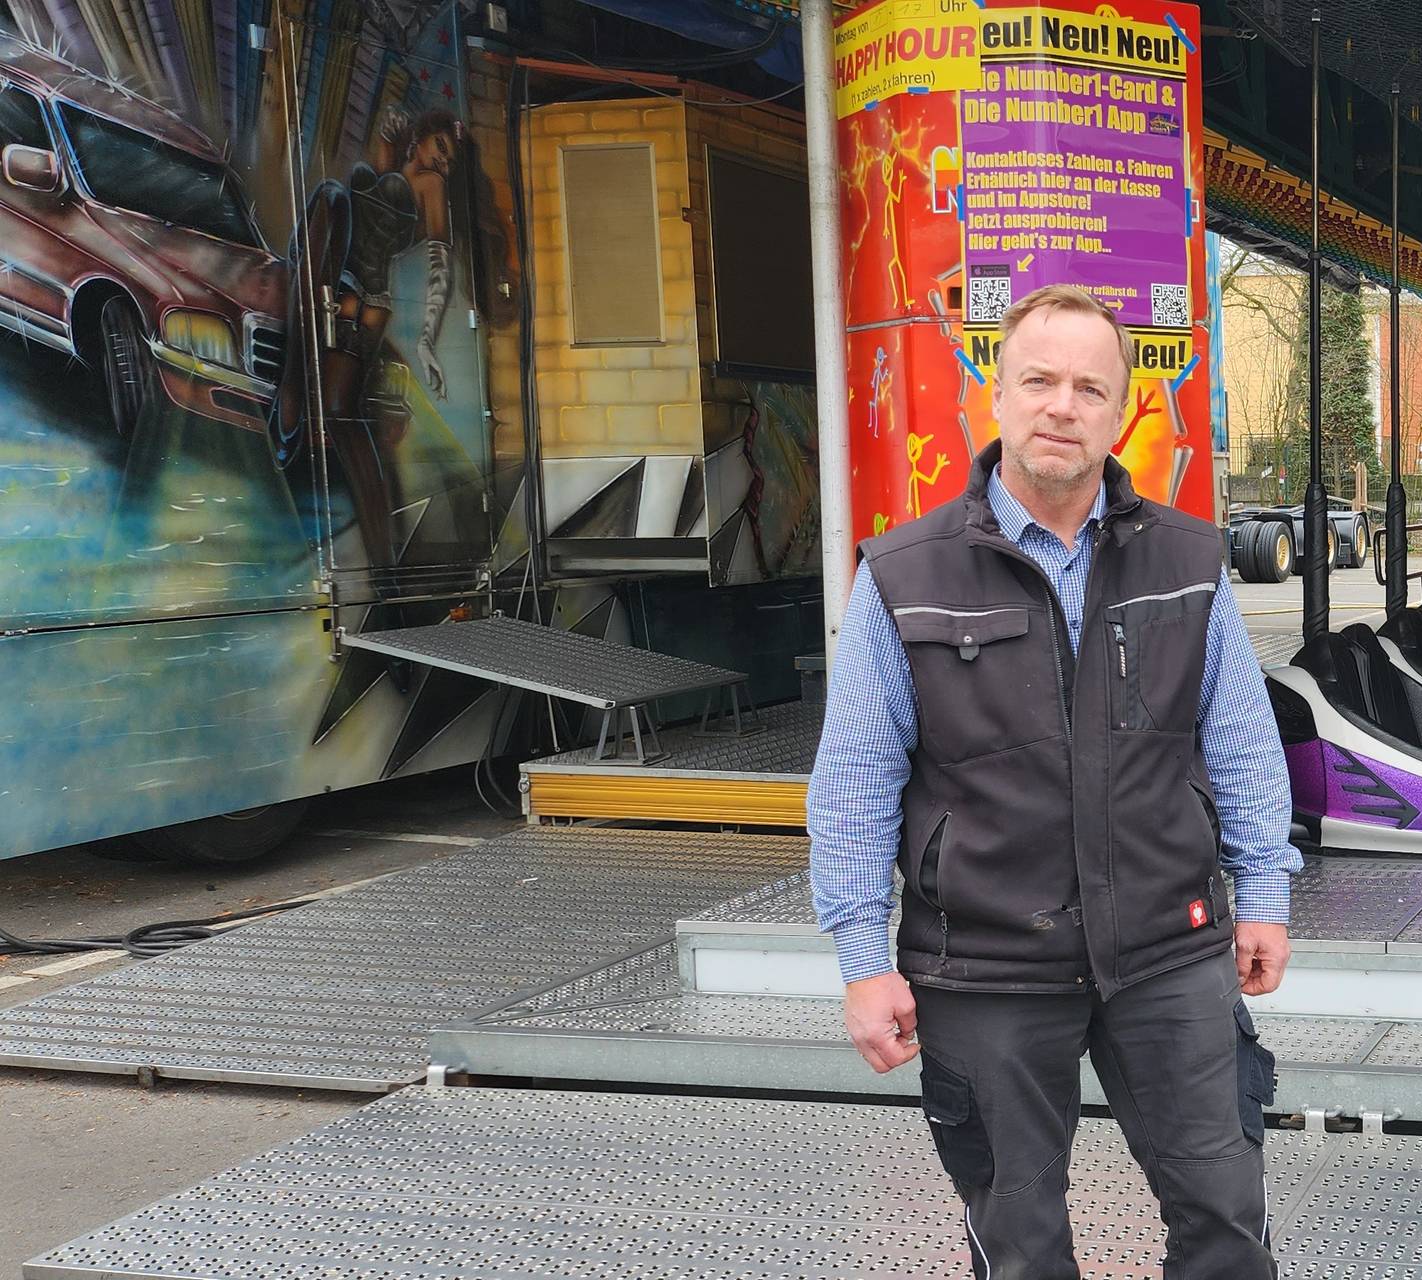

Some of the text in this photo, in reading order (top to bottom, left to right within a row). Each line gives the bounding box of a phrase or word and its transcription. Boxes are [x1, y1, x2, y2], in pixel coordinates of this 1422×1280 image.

[857, 22, 869, 35] von
[940, 0, 967, 13] Uhr
[982, 16, 1180, 65] eu! Neu! Neu!
[836, 25, 977, 90] HAPPY HOUR
[893, 71, 936, 86] fahren)
[1005, 66, 1157, 104] Number1-Card
[1161, 86, 1176, 107] &
[964, 98, 1000, 123] Die
[1006, 98, 1103, 128] Number1
[1107, 105, 1146, 134] App
[966, 151, 1174, 179] Kontaktloses Zahlen & Fahren
[966, 171, 1161, 198] Erhältlich hier an der Kasse
[967, 190, 1091, 211] und im Appstore!
[968, 212, 1107, 232] Jetzt ausprobieren!
[968, 233, 999, 250] Hier
[1002, 232, 1048, 252] geht's
[1050, 235, 1073, 250] zur
[1094, 285, 1125, 297] erfährst
[1127, 288, 1137, 297] du
